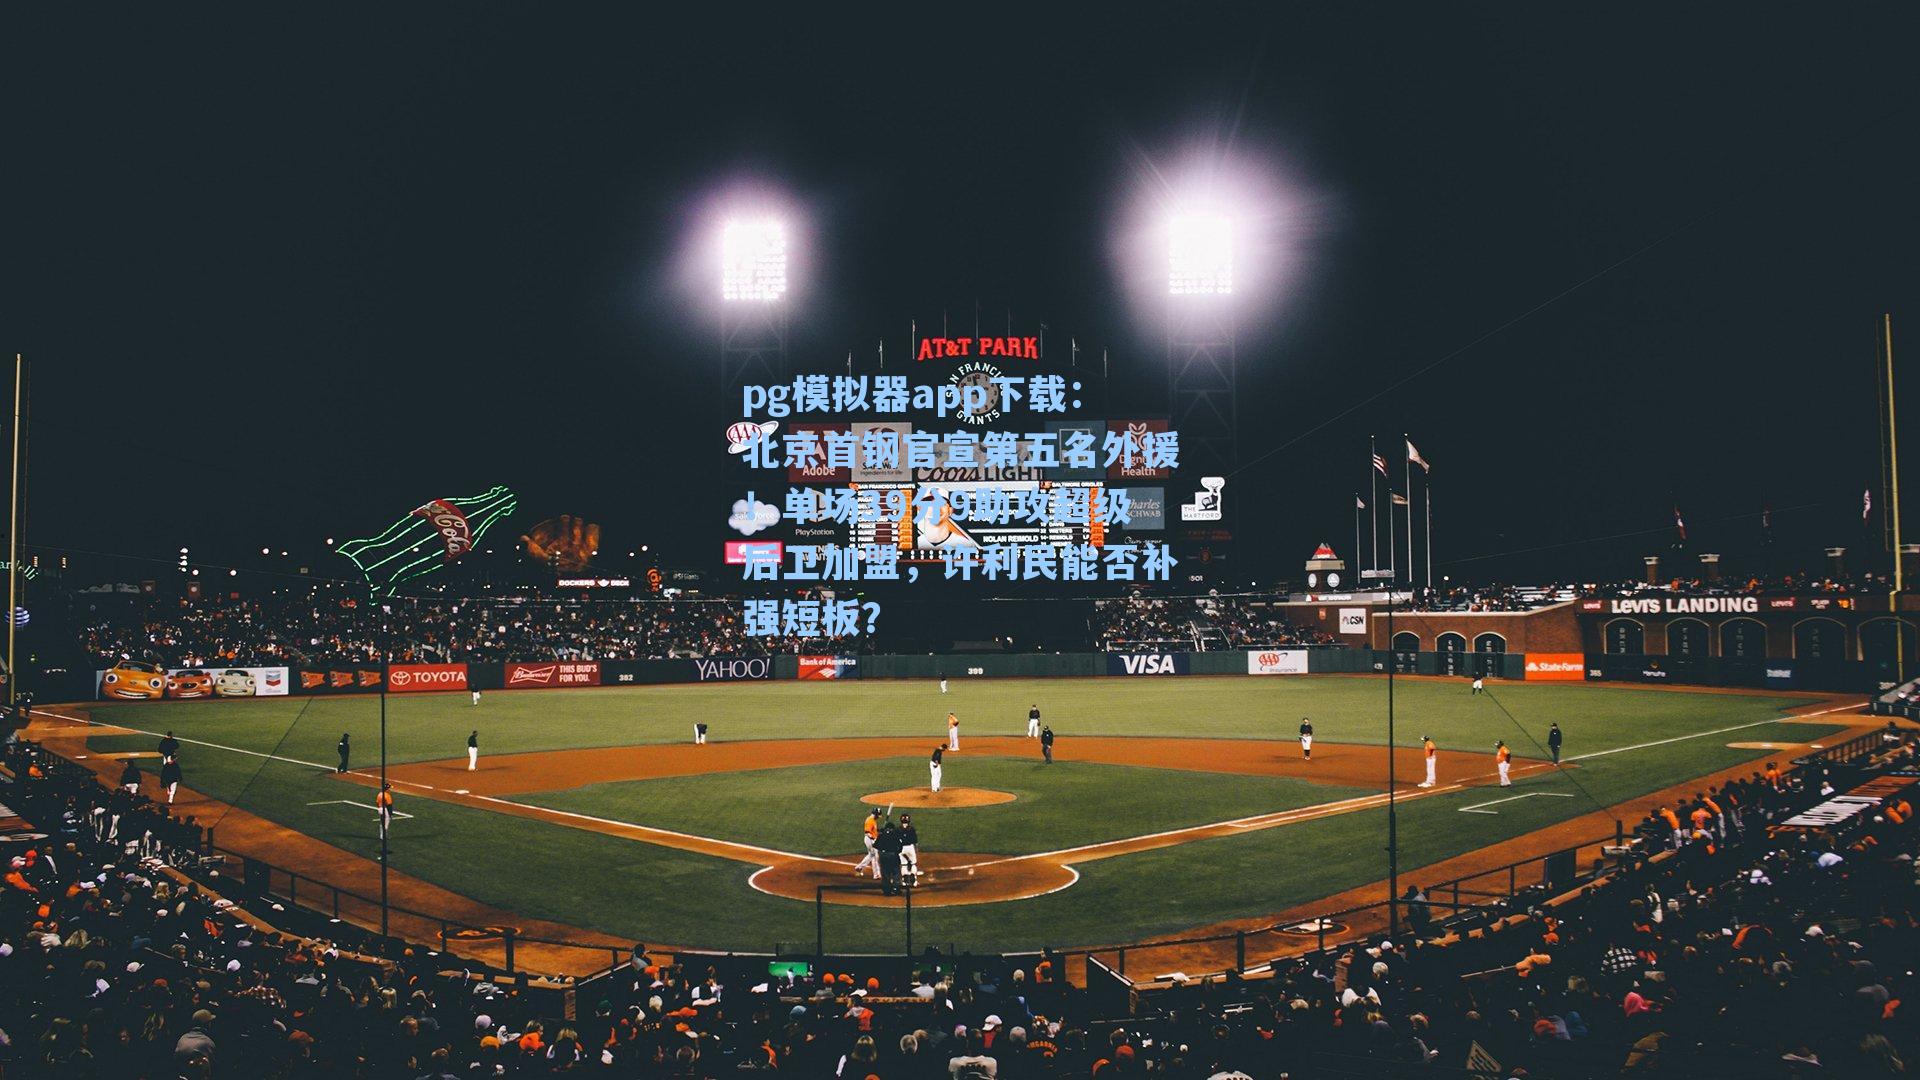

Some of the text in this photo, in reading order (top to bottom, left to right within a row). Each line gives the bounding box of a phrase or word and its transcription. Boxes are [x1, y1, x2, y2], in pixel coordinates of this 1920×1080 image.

[918, 336, 1038, 360] AT&T PARK
[802, 464, 837, 476] Adobe
[1121, 467, 1156, 477] Health
[1129, 499, 1160, 509] harles
[795, 528, 835, 537] PlayStation
[1666, 597, 1758, 613] LANDING
[1349, 616, 1364, 625] CSN
[800, 658, 856, 666] Bank of America
[1119, 654, 1176, 674] VISA
[1539, 663, 1584, 671] State Farm
[560, 664, 598, 673] THIS BUD'S
[696, 658, 771, 680] YAHOO!
[413, 671, 467, 683] TOYOTA
[560, 673, 590, 683] FOR YOU.
